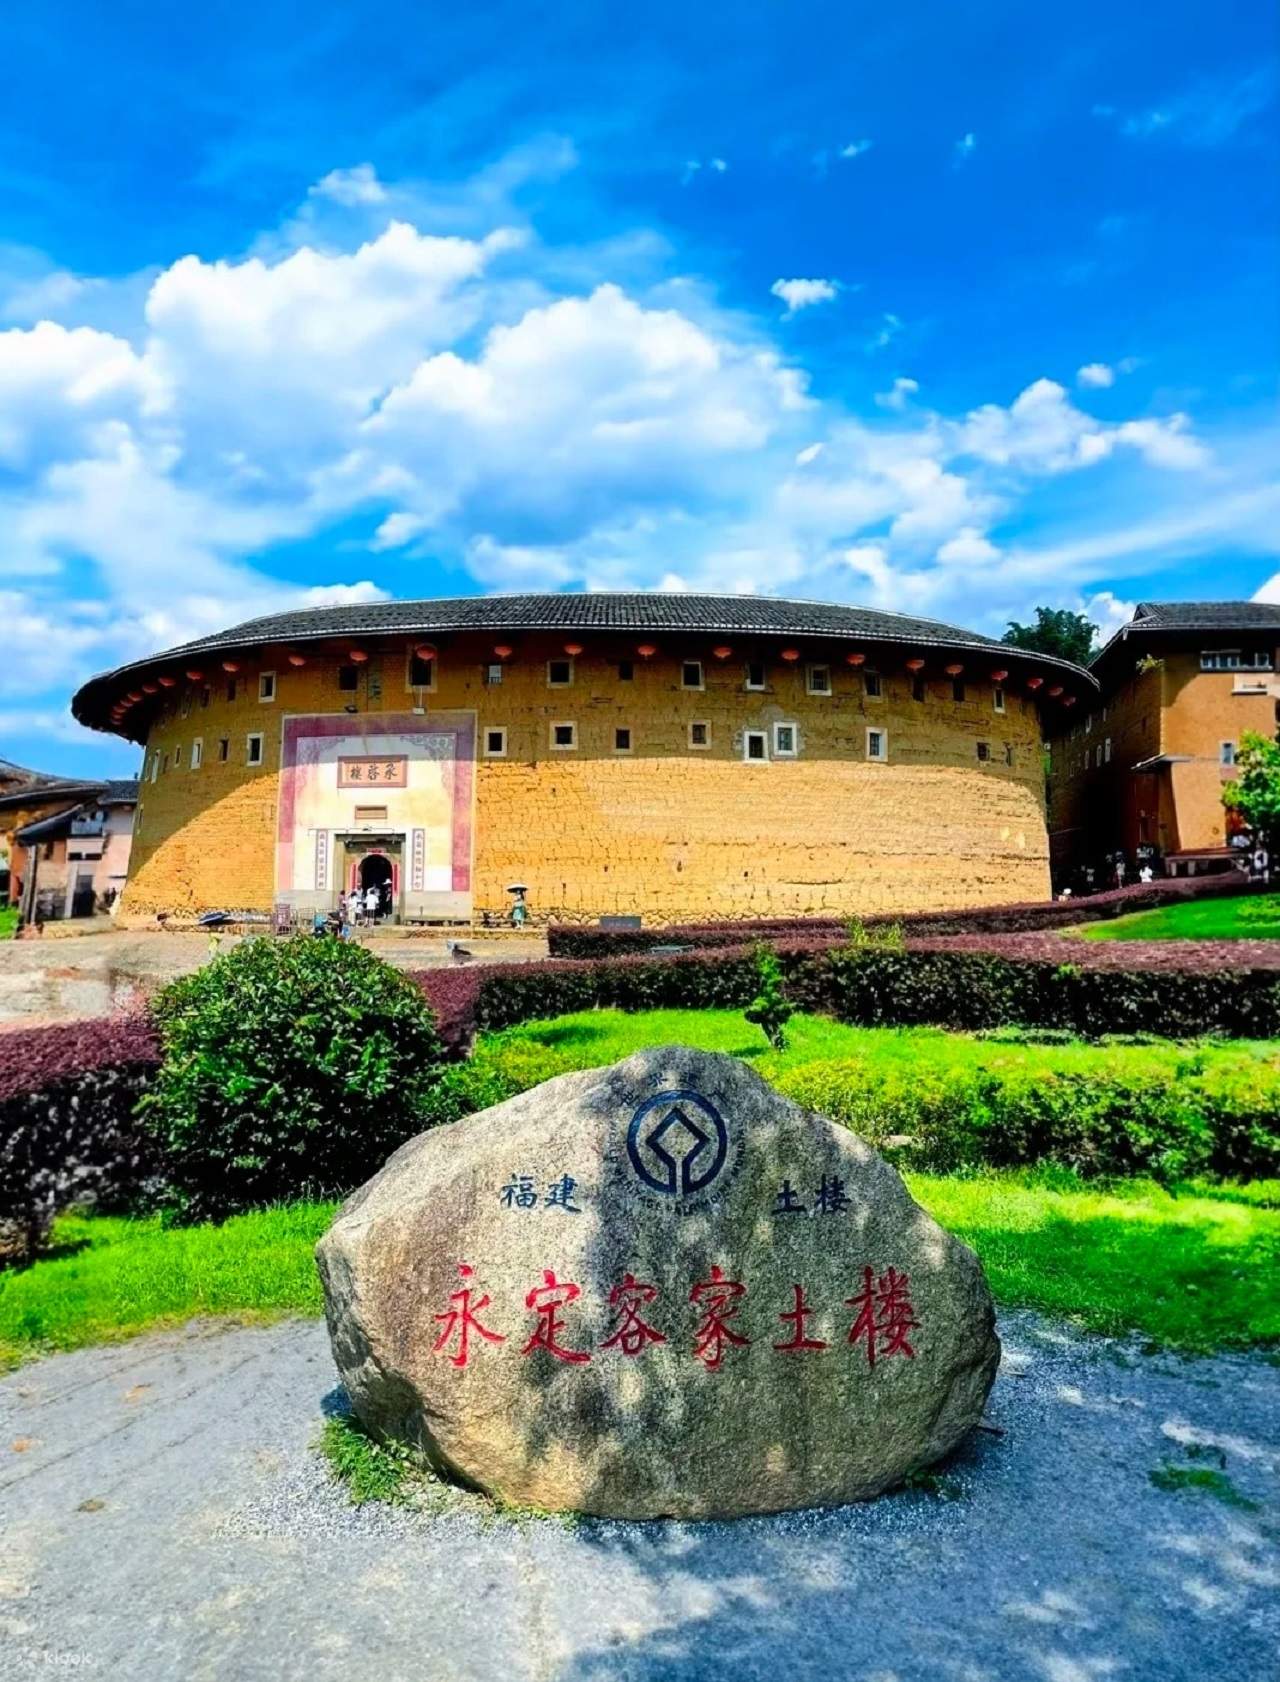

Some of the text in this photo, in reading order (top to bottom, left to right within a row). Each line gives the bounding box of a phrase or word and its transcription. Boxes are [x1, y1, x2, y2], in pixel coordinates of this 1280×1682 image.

[501, 1173, 582, 1212] 福建
[772, 1173, 850, 1213] 土楼
[433, 1265, 920, 1370] 永定客家土楼
